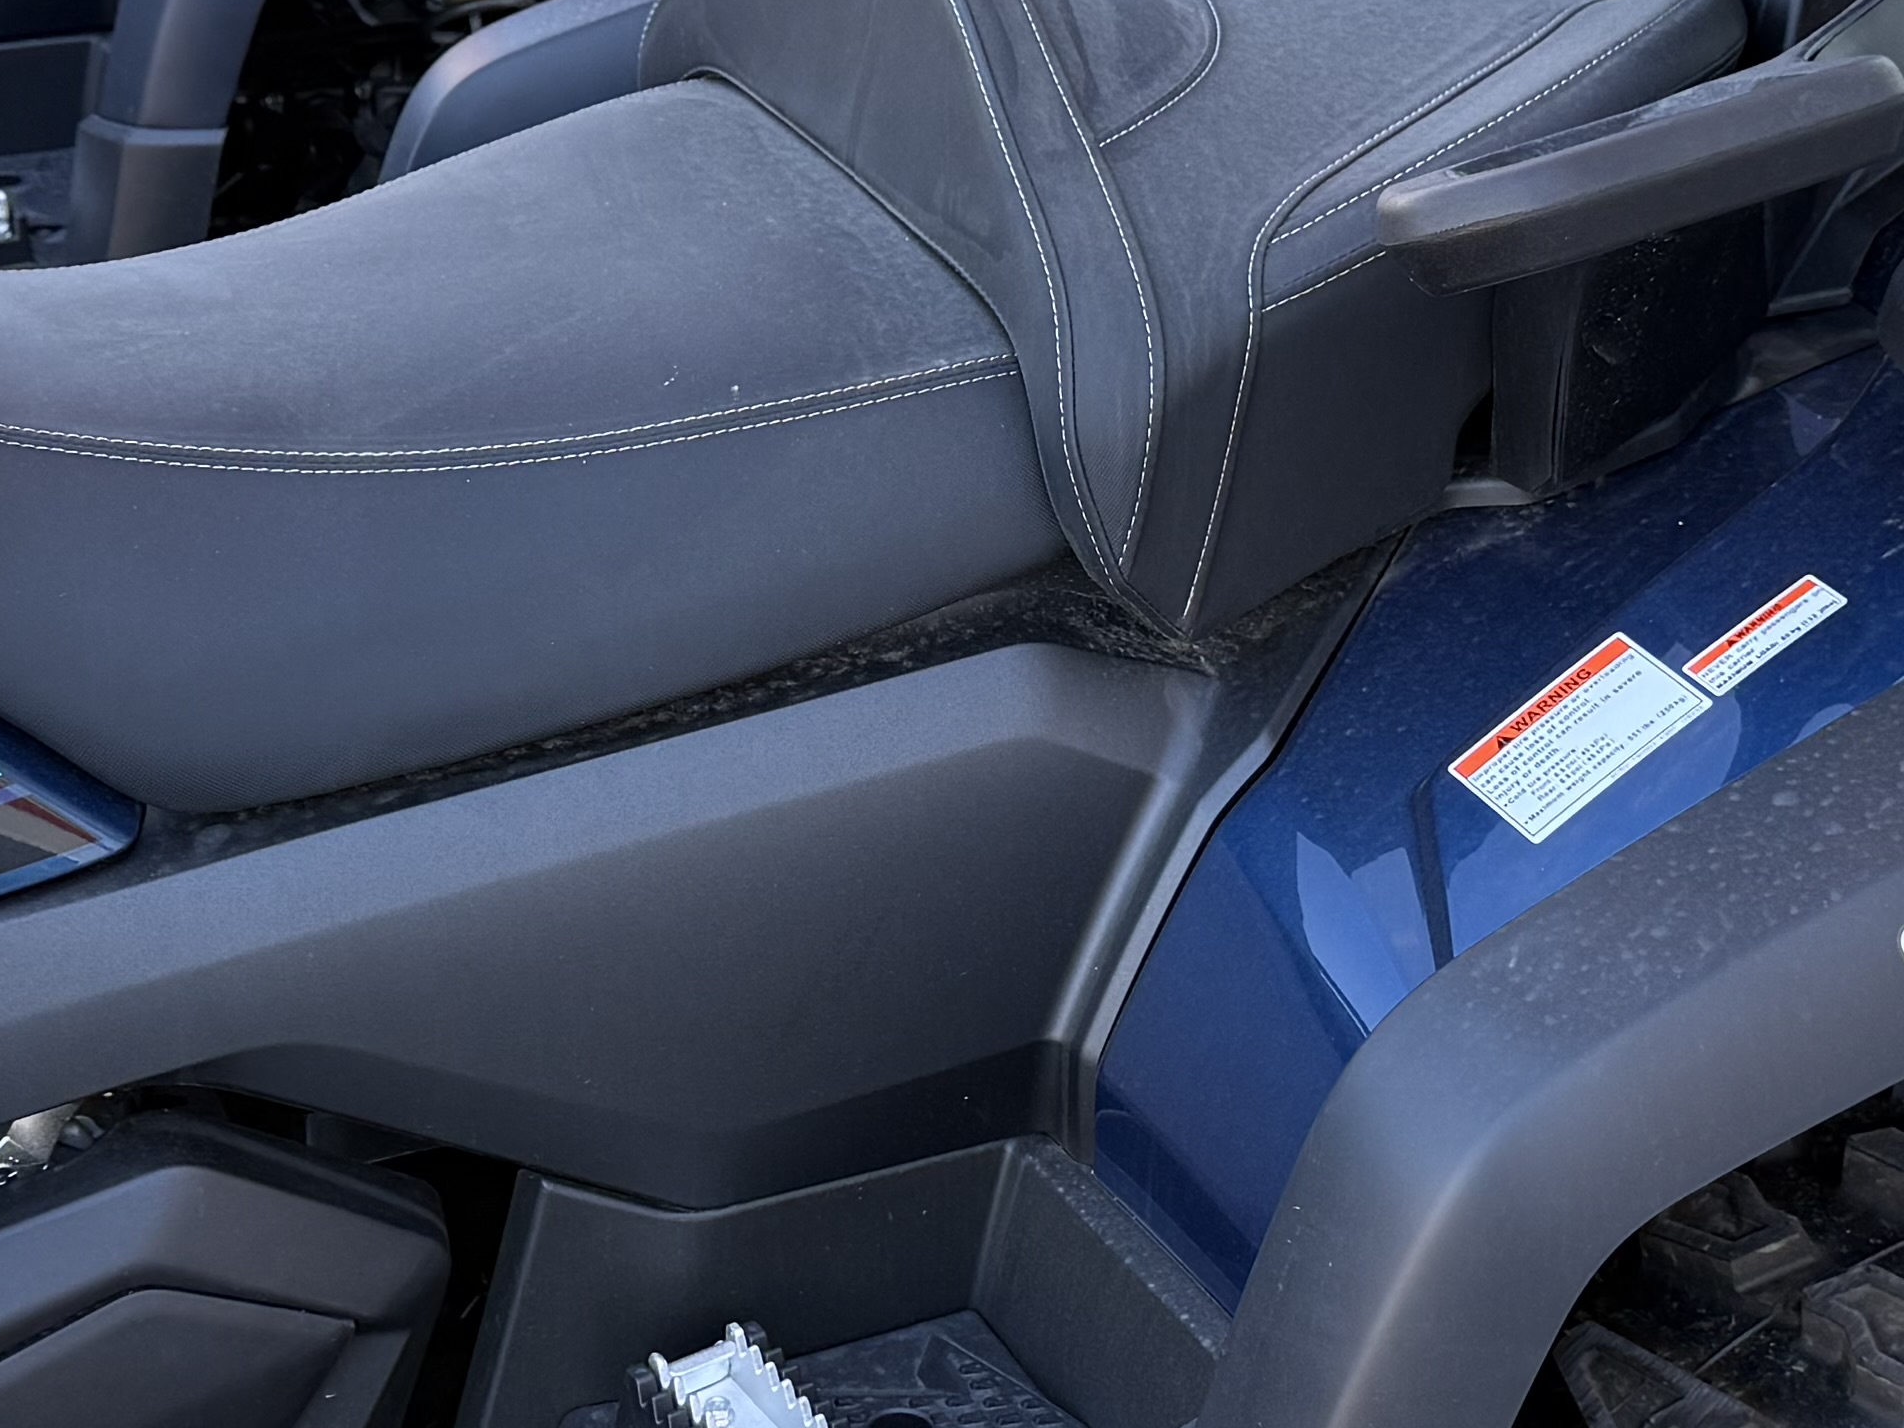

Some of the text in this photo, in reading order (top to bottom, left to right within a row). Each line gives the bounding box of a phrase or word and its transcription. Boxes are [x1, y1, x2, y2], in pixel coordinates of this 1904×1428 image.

[1735, 603, 1782, 639] WARNING
[1510, 667, 1592, 733] WARNING
[1484, 773, 1509, 795] Loss
[1520, 737, 1554, 765] control
[1570, 700, 1599, 724] result
[1611, 668, 1642, 692] severe
[1496, 751, 1524, 774] cause
[1522, 732, 1544, 751] loss
